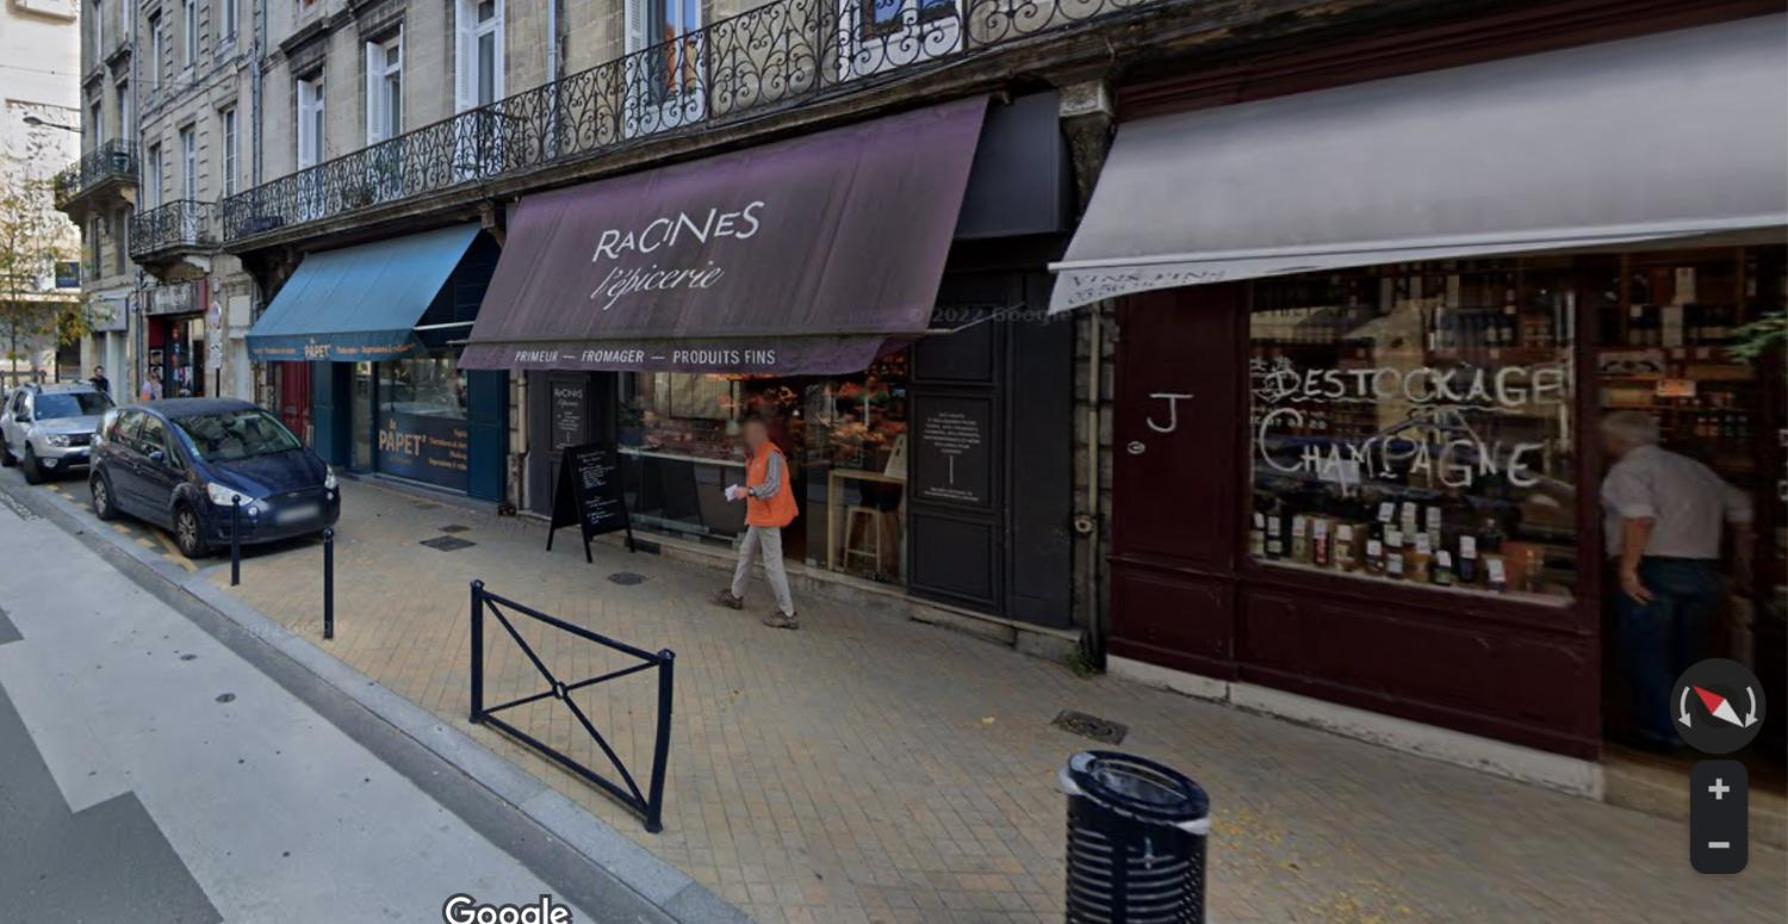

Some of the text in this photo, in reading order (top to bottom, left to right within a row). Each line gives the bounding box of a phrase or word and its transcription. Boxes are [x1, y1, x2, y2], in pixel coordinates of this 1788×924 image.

[592, 200, 766, 263] RACINES
[590, 260, 725, 311] l'épicerie
[514, 350, 559, 364] PRIMEUR
[580, 349, 645, 364] FROMAGER
[672, 350, 740, 365] PRODUITS
[744, 350, 776, 366] FINS
[1262, 366, 1566, 407] DESTOCKAGE
[1145, 392, 1196, 434] J
[378, 429, 427, 457] PAPET'
